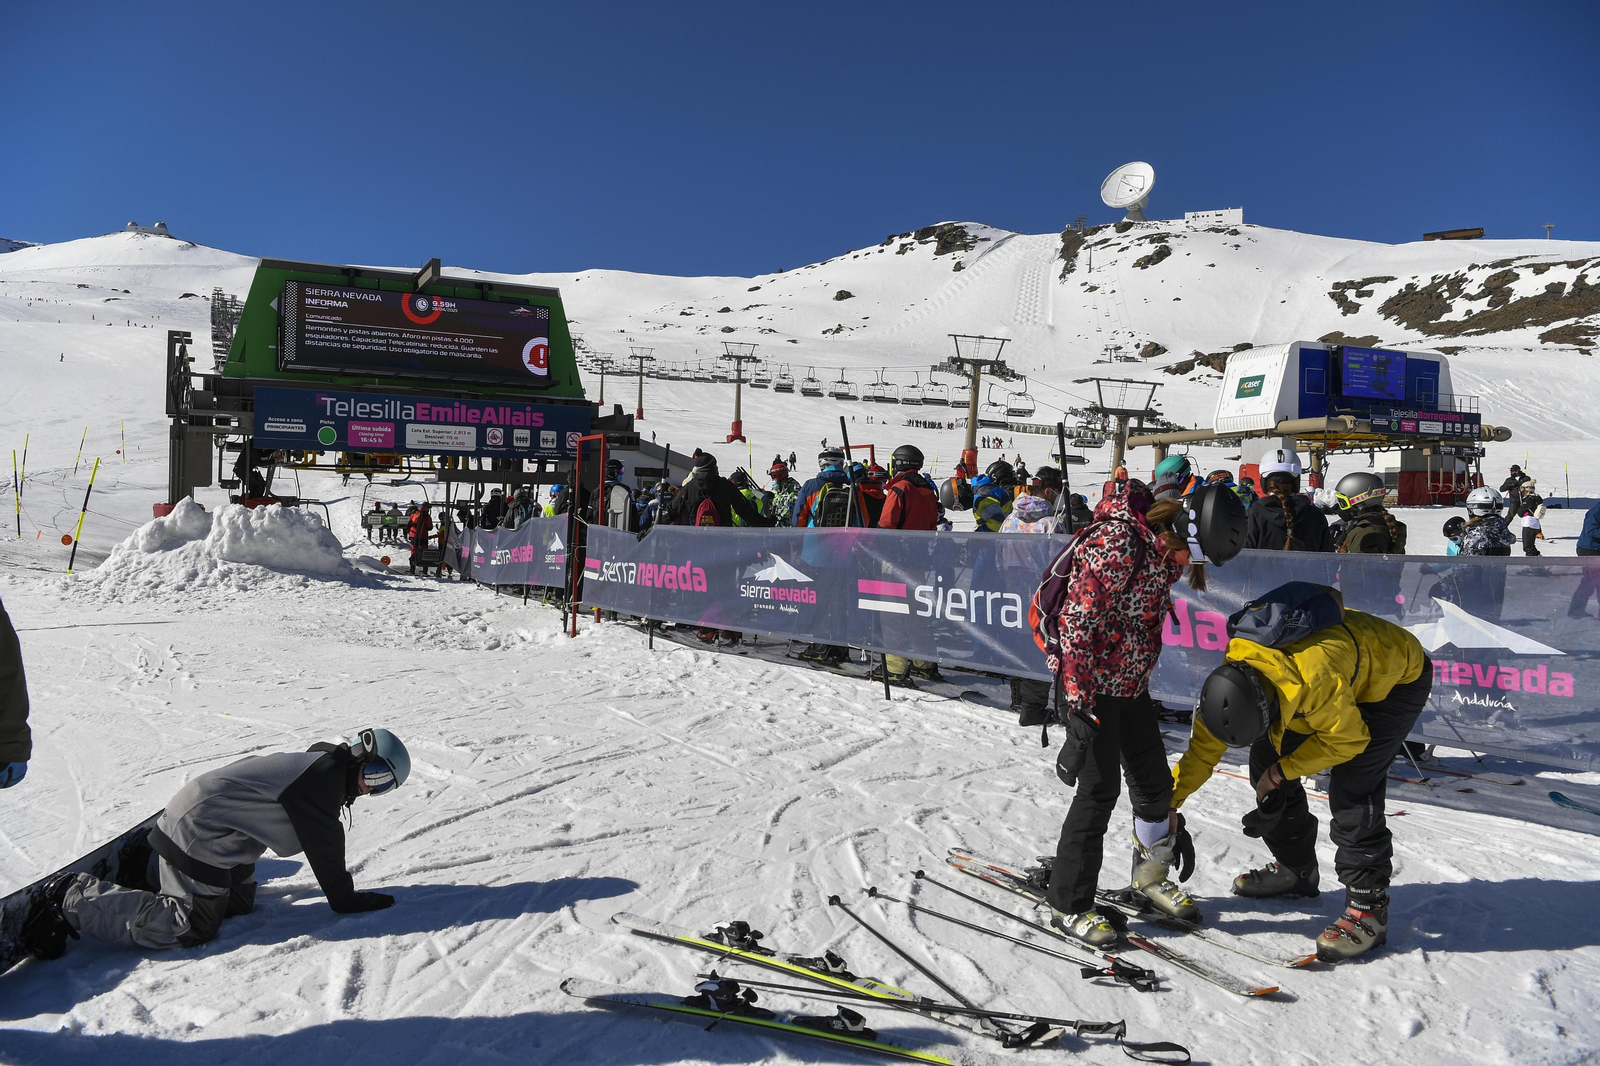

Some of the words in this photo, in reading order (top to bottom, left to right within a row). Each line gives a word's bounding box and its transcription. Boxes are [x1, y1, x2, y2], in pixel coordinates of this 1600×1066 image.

[305, 288, 340, 298] SIERRA
[342, 292, 382, 302] NEVADA
[305, 298, 348, 308] INFORMA
[305, 313, 342, 321] Comunicado
[305, 325, 342, 333] Remontes
[349, 328, 370, 336] pistas
[371, 330, 400, 338] abiertos.
[305, 333, 351, 341] esquiadores.
[352, 336, 386, 345] Capacidad
[352, 343, 388, 352] seguridad.
[403, 348, 438, 356] obligatorio
[449, 351, 483, 359] mascarilla.
[1245, 380, 1261, 388] caser
[1452, 690, 1517, 712] Andalucía
